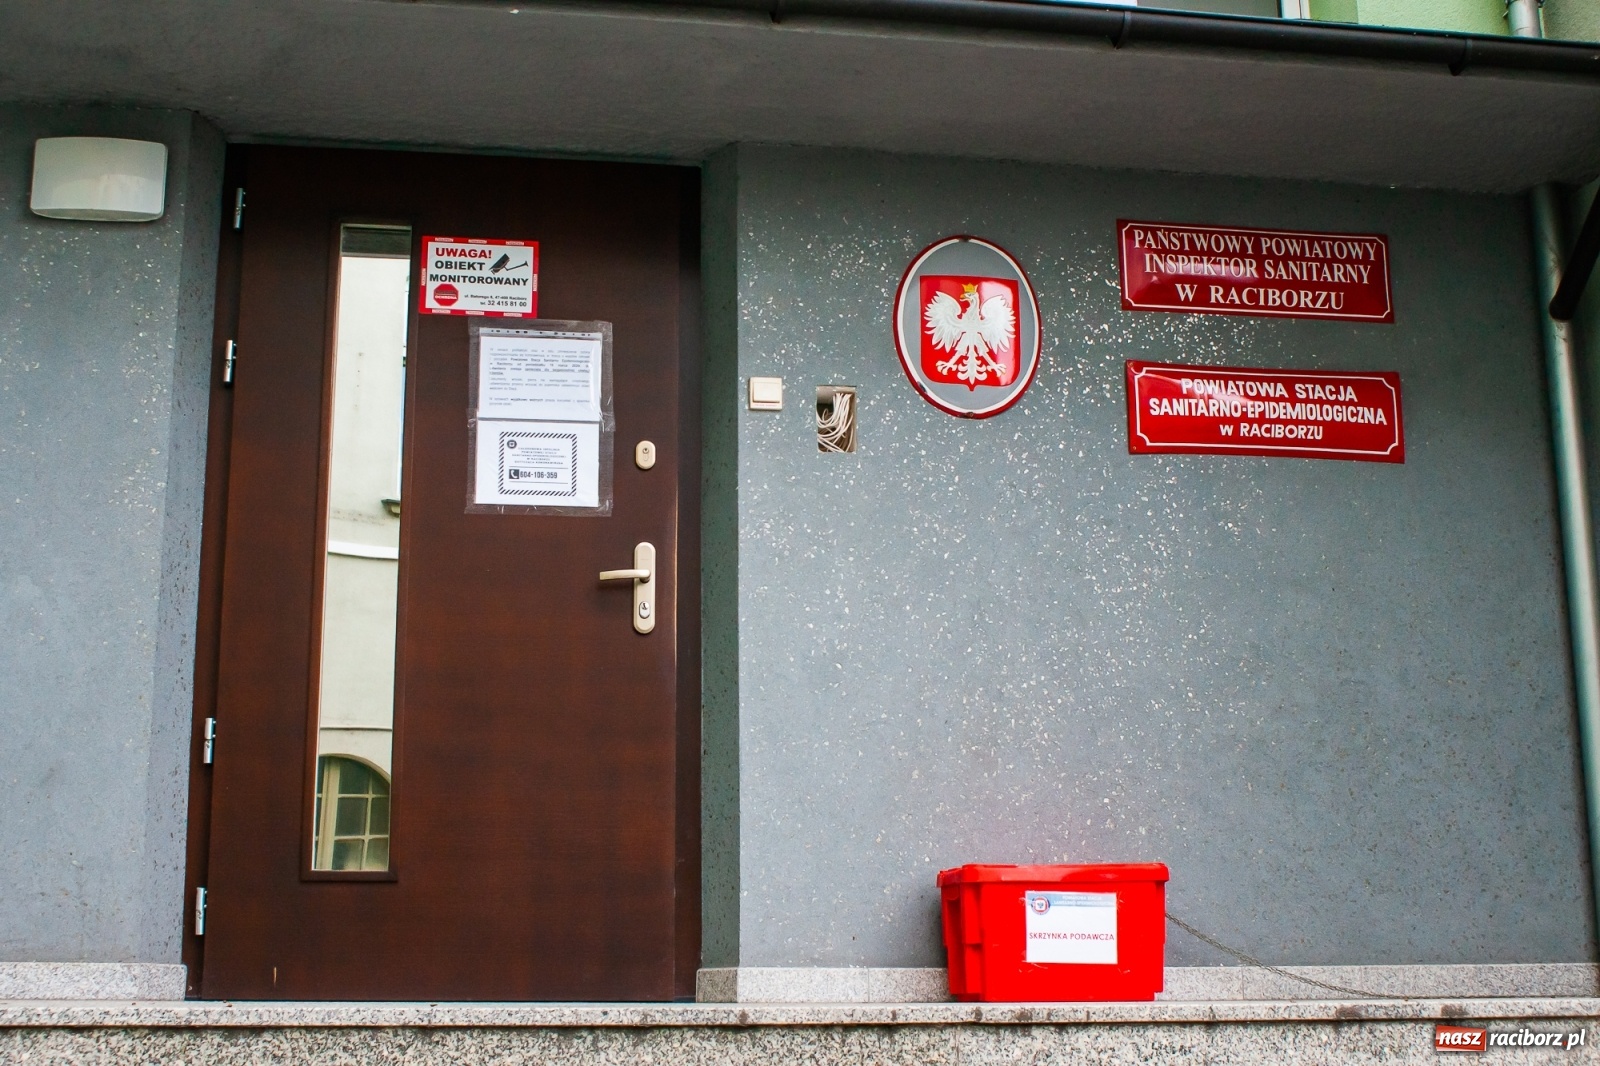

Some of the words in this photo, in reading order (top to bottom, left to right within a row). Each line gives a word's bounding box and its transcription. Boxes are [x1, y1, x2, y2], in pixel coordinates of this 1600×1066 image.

[435, 247, 492, 259] UWAGA!
[1133, 229, 1255, 254] PAŃSTWOWY
[1260, 236, 1377, 261] POWIATOWY
[435, 260, 486, 271] OBIEKT
[1144, 253, 1259, 278] INSPEKTOR
[1264, 259, 1371, 284] SANITARNY
[429, 274, 529, 286] MONITOROWANY
[1175, 283, 1198, 302] W
[1209, 285, 1344, 310] RACIBORZU
[1180, 378, 1289, 398] POWIATOWA
[1296, 383, 1358, 402] STACJA
[1149, 397, 1387, 425] SANITARNO-EPIDEMIOLOGICZNA
[1240, 423, 1323, 440] RACIBORZU
[519, 471, 558, 479] 604-106-359
[1029, 932, 1068, 940] SKRZYNKA
[1069, 933, 1115, 941] PODAWCZA
